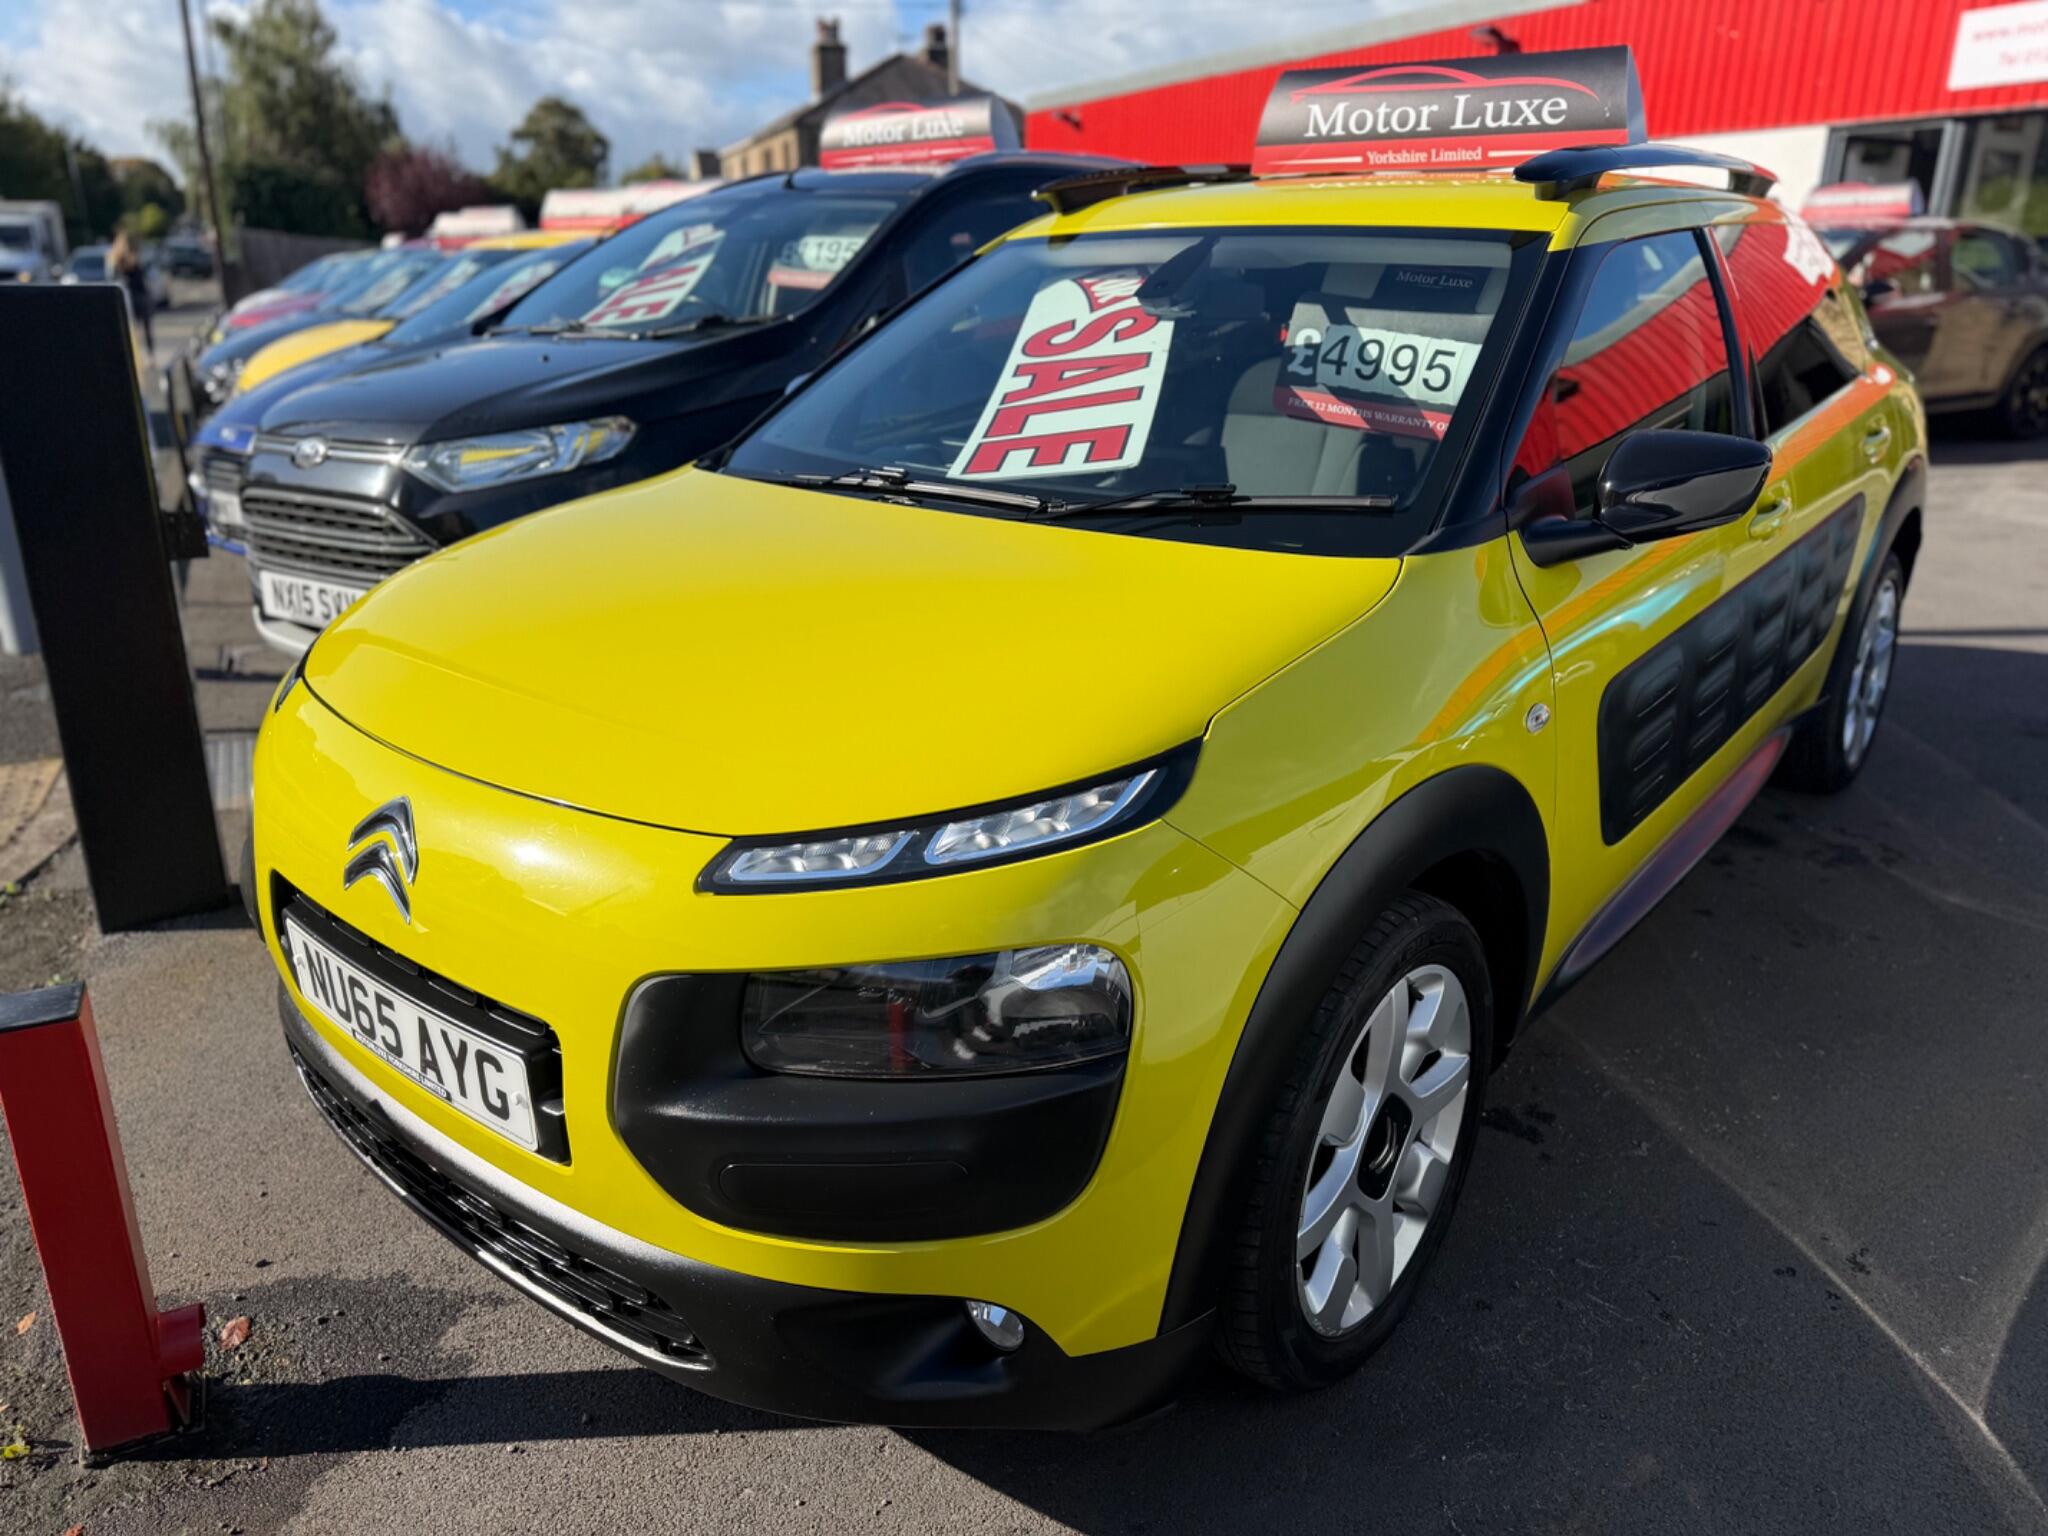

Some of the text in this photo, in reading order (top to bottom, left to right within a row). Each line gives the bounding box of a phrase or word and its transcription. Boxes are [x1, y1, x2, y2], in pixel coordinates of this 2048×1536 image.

[842, 116, 965, 147] Motor Luxe
[1303, 94, 1568, 138] Motor Luxe
[1366, 146, 1483, 165] Yorkshire Limited
[1396, 270, 1438, 284] Motor
[1439, 274, 1473, 289] Luxe
[1287, 328, 1457, 393] £4995
[961, 304, 1160, 475] SALE
[1288, 396, 1313, 409] FREE
[1315, 401, 1327, 412] 12
[1327, 403, 1373, 420] MONTHS
[1374, 410, 1437, 429] WARRANTY
[271, 578, 315, 617] NX15
[302, 939, 510, 1121] NU65 AYG
